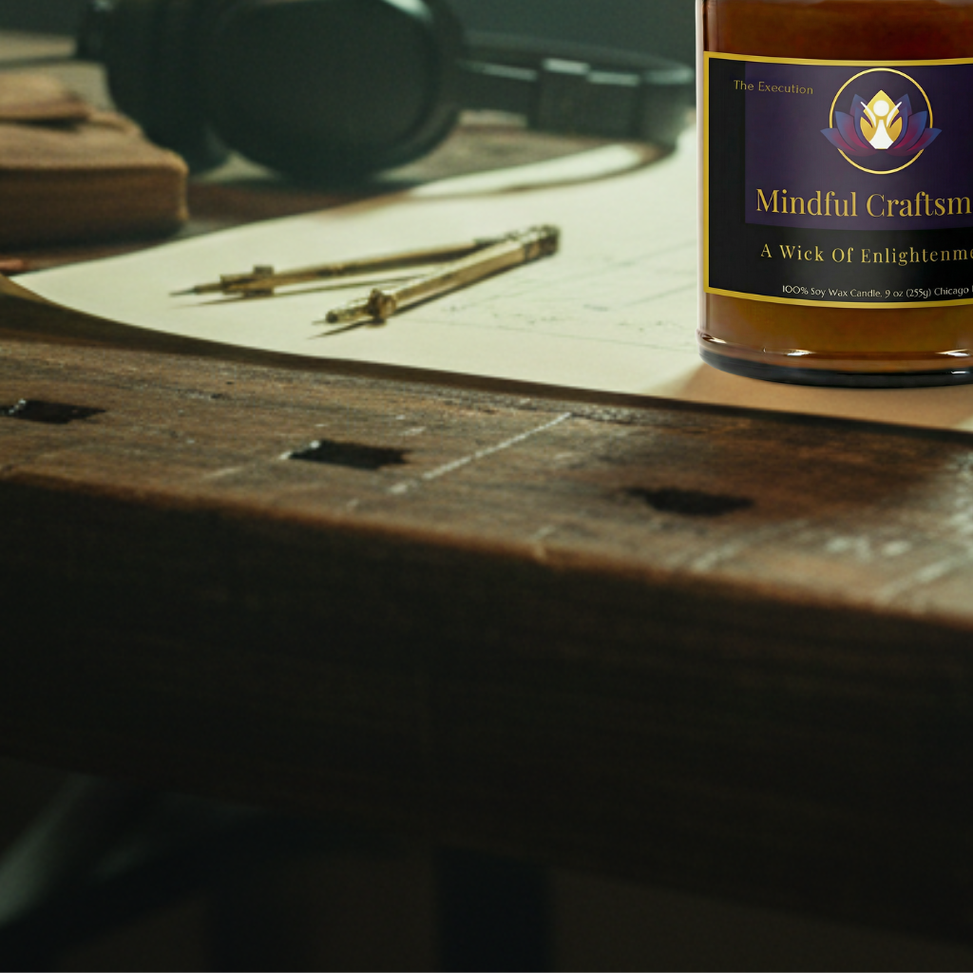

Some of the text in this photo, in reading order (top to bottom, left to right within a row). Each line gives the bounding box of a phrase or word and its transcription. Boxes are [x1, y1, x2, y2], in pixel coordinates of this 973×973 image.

[733, 80, 813, 94] The Execution
[756, 189, 858, 217] Mindful
[760, 243, 772, 259] A
[779, 245, 824, 262] Wick
[832, 247, 854, 263] Of
[782, 285, 809, 295] 100%
[810, 287, 827, 298] Soy
[828, 288, 848, 297] Wax
[884, 289, 891, 299] 9
[892, 290, 904, 298] oz
[905, 288, 932, 299] (255g)
[933, 286, 970, 297] Chicago
